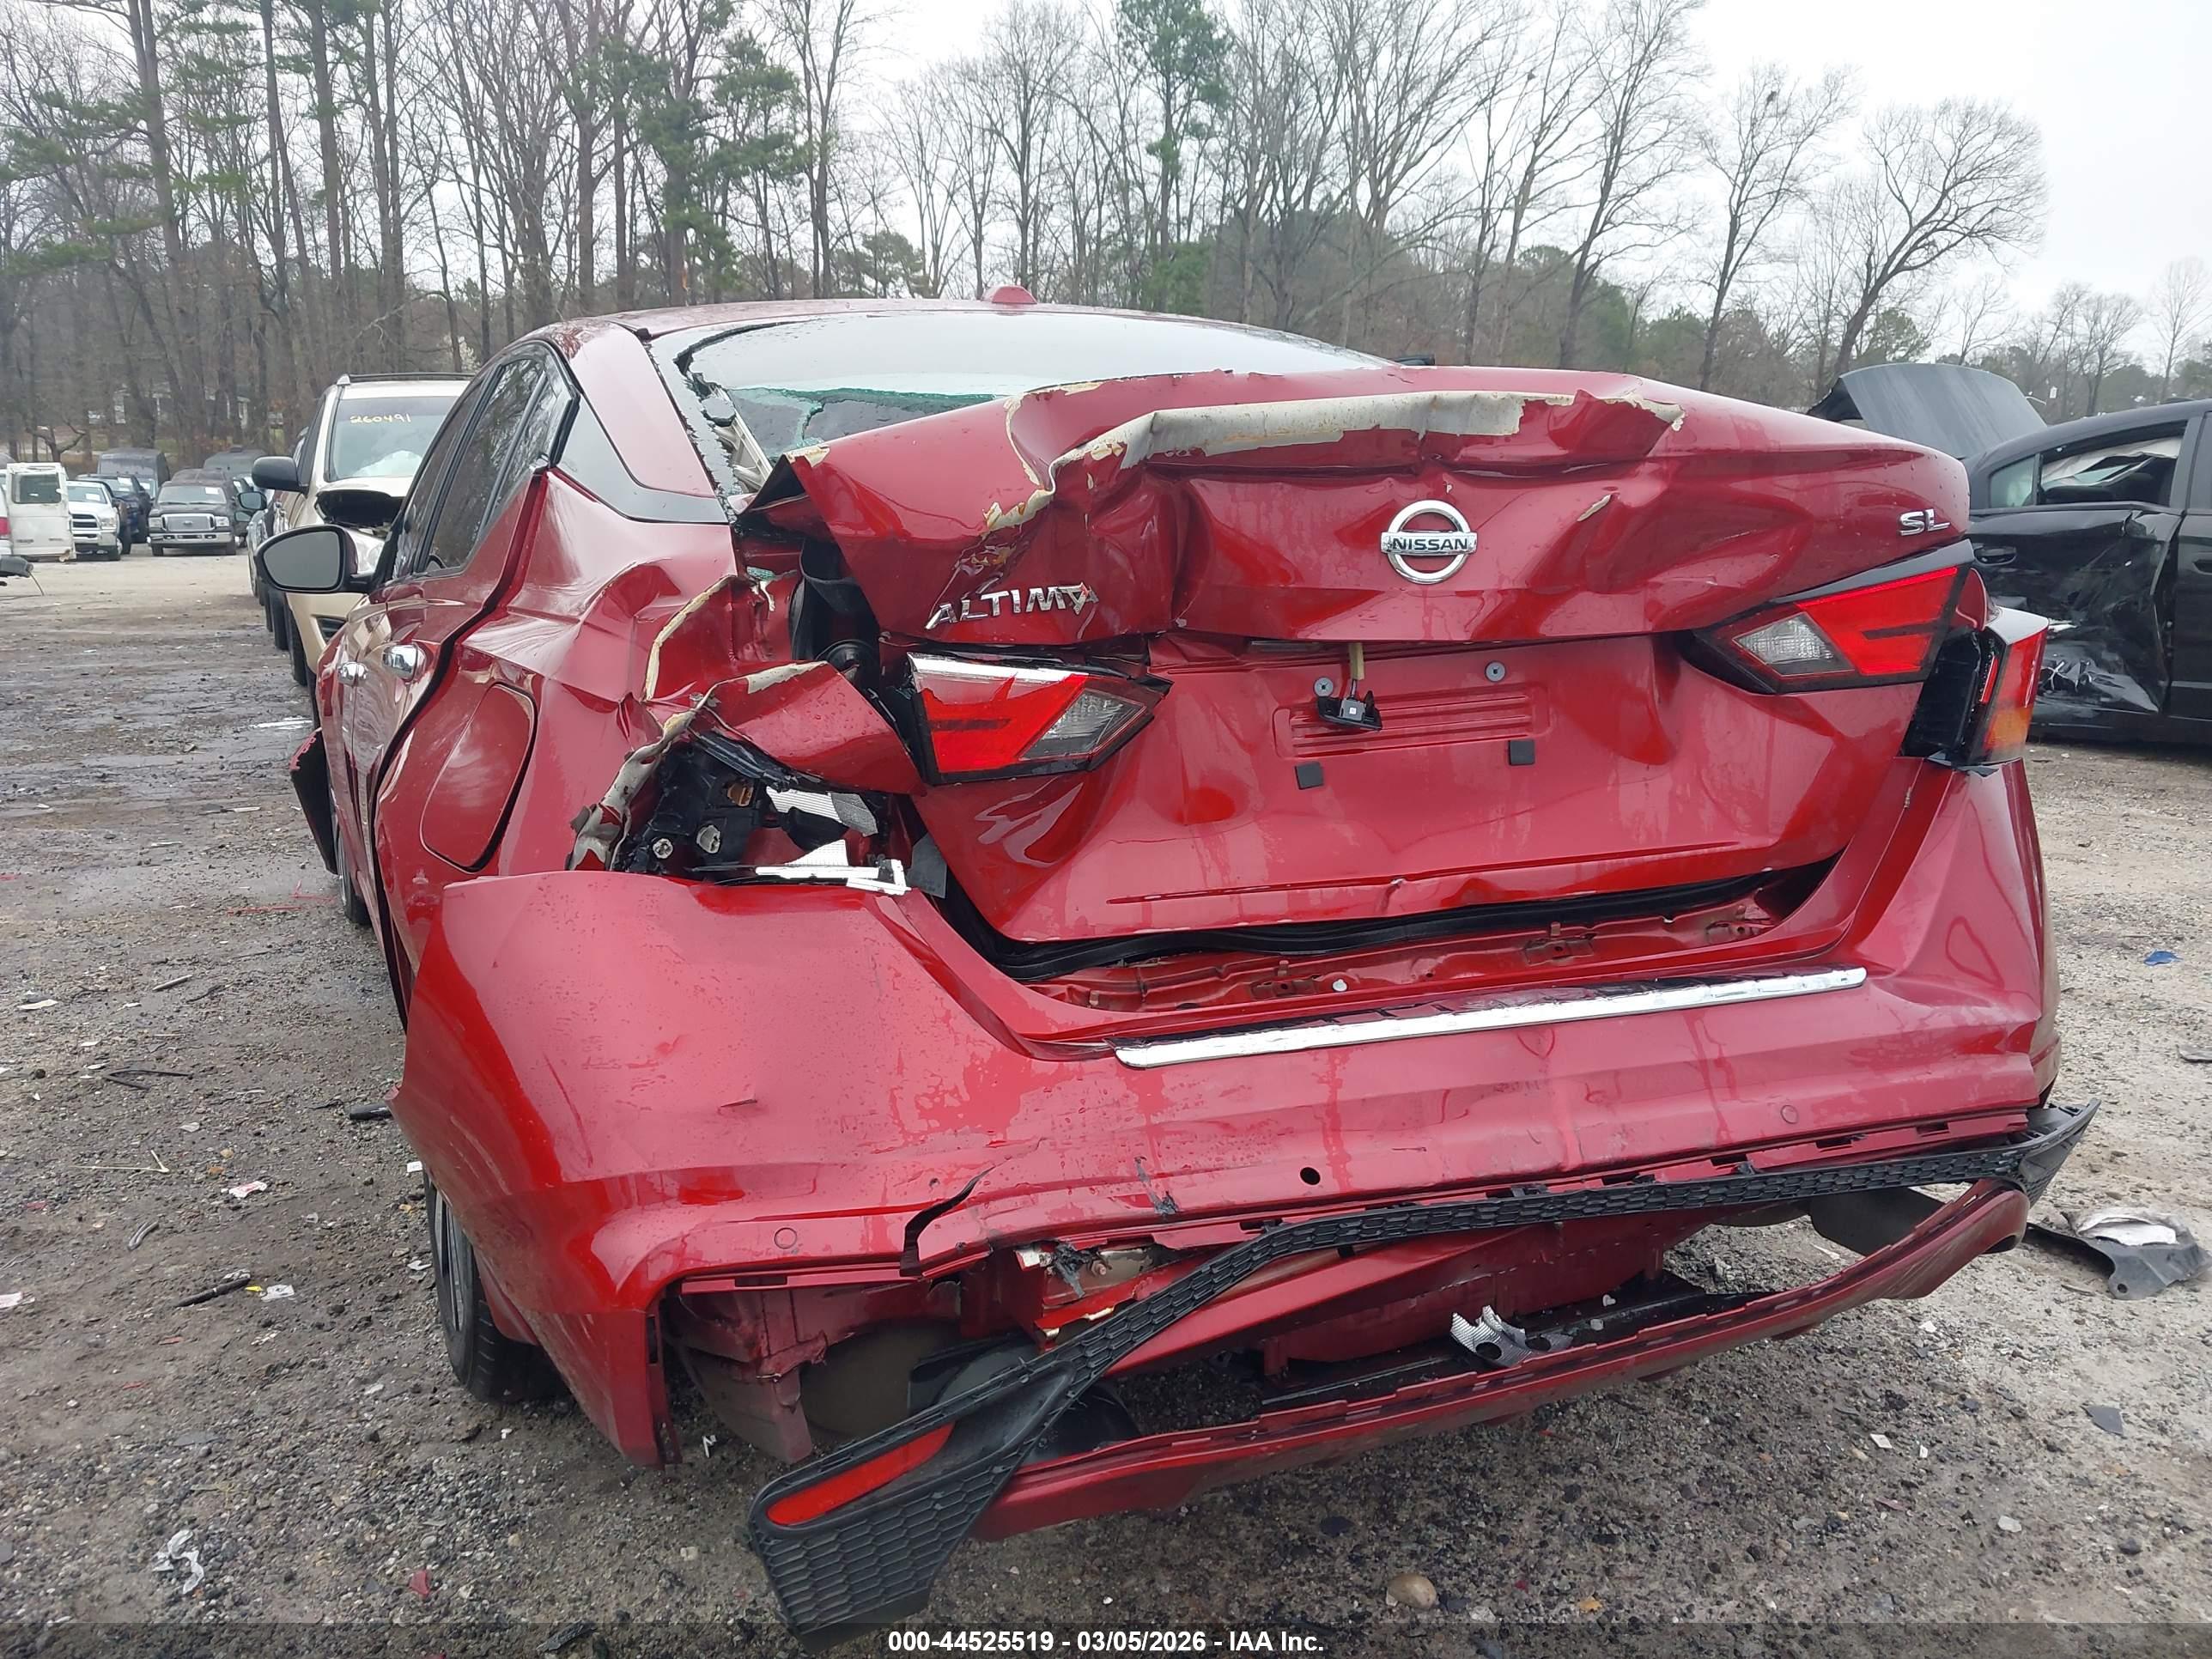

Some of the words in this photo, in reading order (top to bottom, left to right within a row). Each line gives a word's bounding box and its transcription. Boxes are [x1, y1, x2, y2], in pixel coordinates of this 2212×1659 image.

[349, 413, 411, 424] 260491
[1899, 508, 1951, 537] SL
[1392, 538, 1468, 550] NISSAN
[925, 582, 1099, 629] ALTIMA
